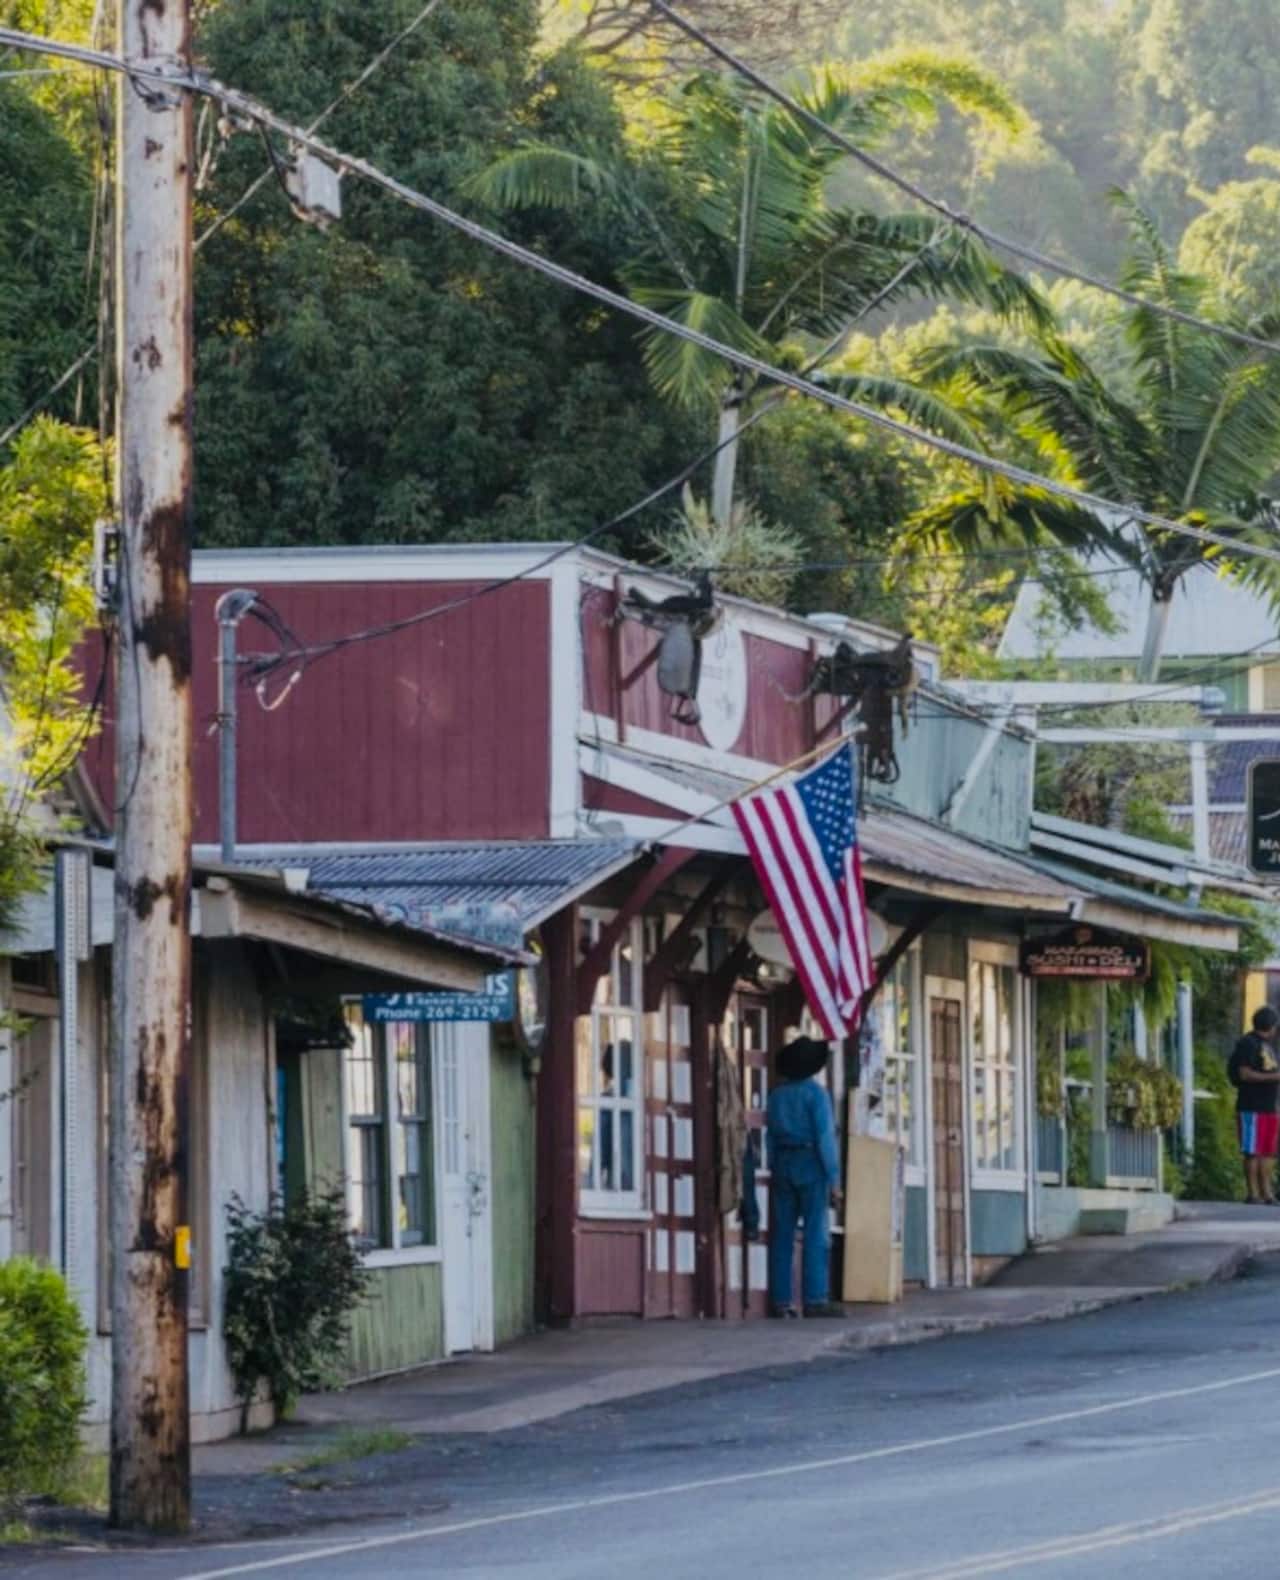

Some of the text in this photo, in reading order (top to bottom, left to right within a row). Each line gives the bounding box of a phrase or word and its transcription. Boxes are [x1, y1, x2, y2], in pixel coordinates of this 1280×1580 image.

[1026, 953, 1143, 968] SUSHI DELI
[374, 1005, 500, 1019] Phone 269-2129
